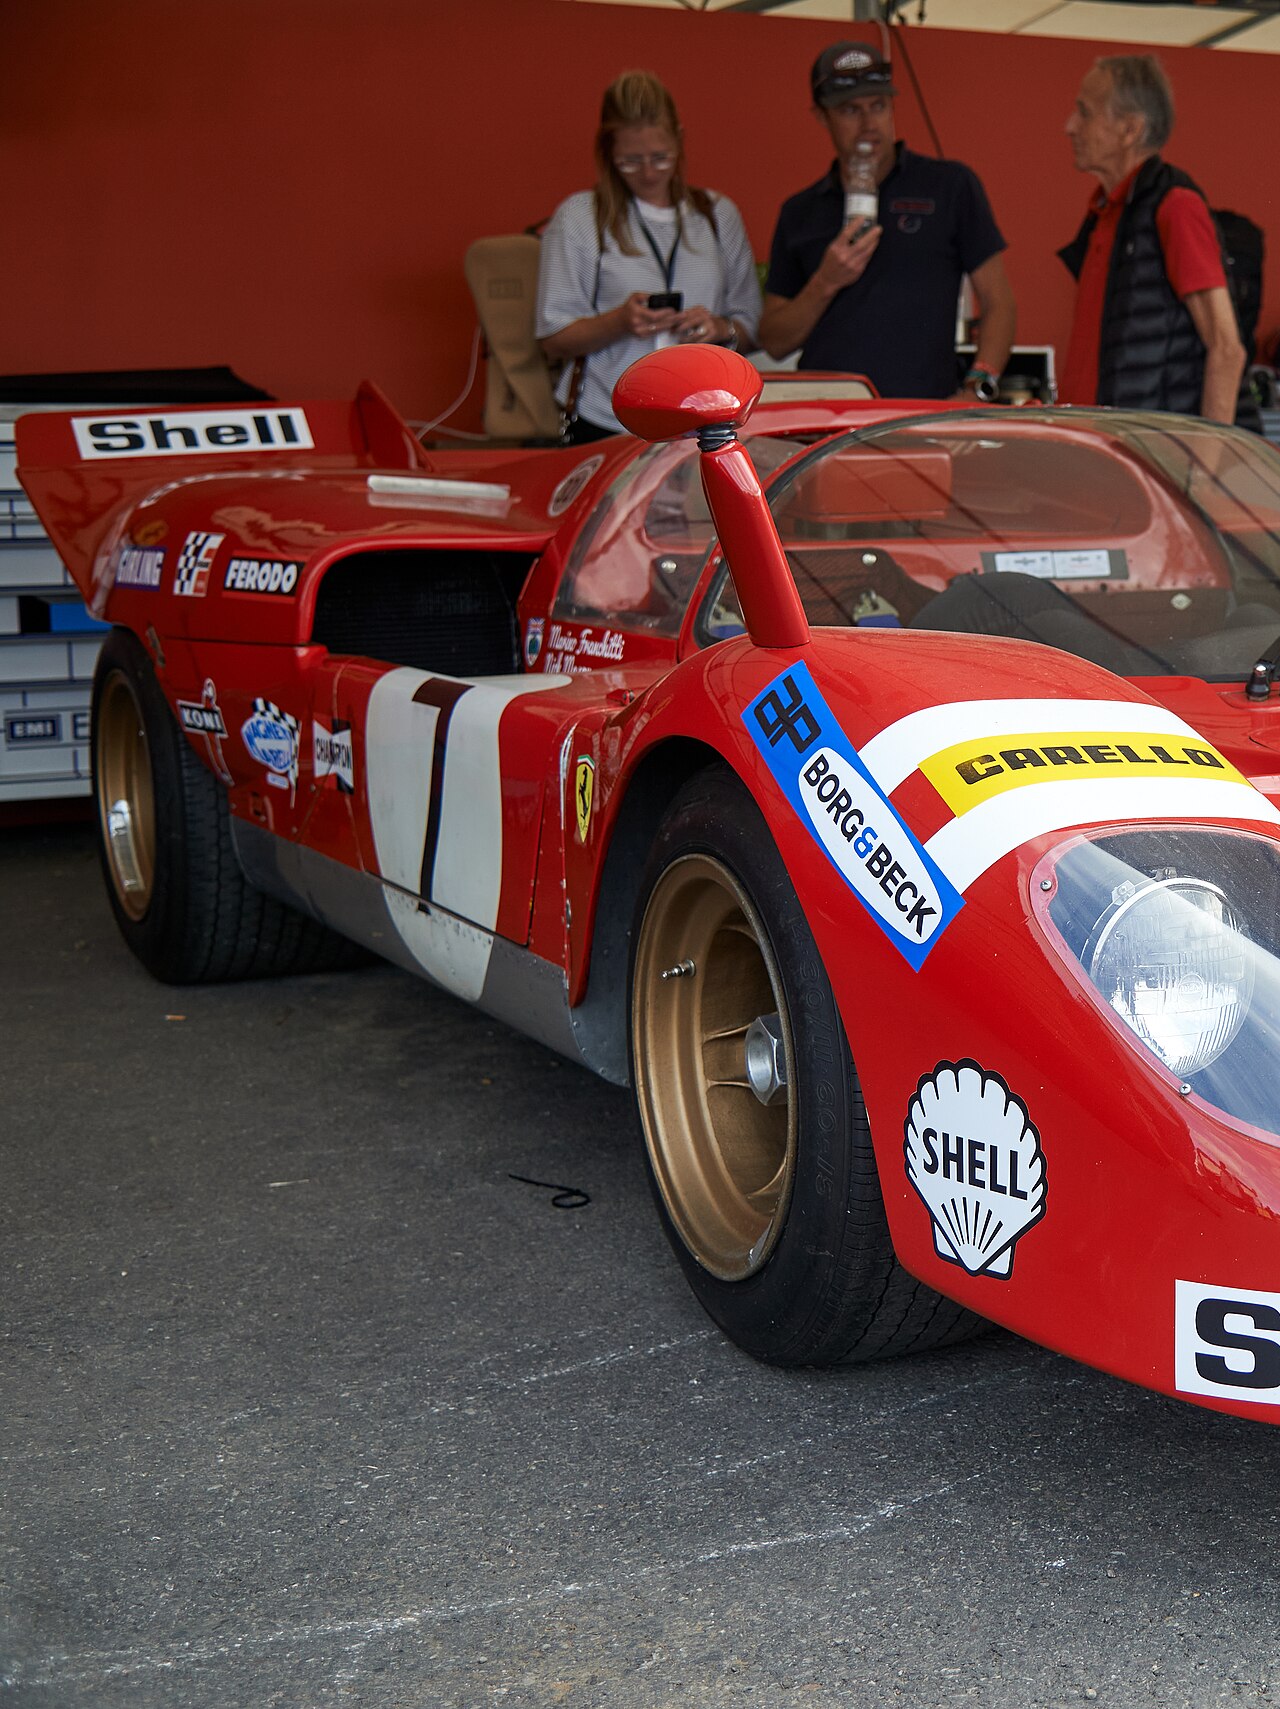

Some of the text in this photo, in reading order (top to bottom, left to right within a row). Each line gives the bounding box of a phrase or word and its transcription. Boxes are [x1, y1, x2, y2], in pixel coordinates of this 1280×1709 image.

[88, 415, 299, 452] Shell
[225, 560, 298, 593] FERODO
[183, 706, 223, 733] KONI
[955, 745, 1225, 785] CARELLO
[922, 1128, 1028, 1201] SHELL
